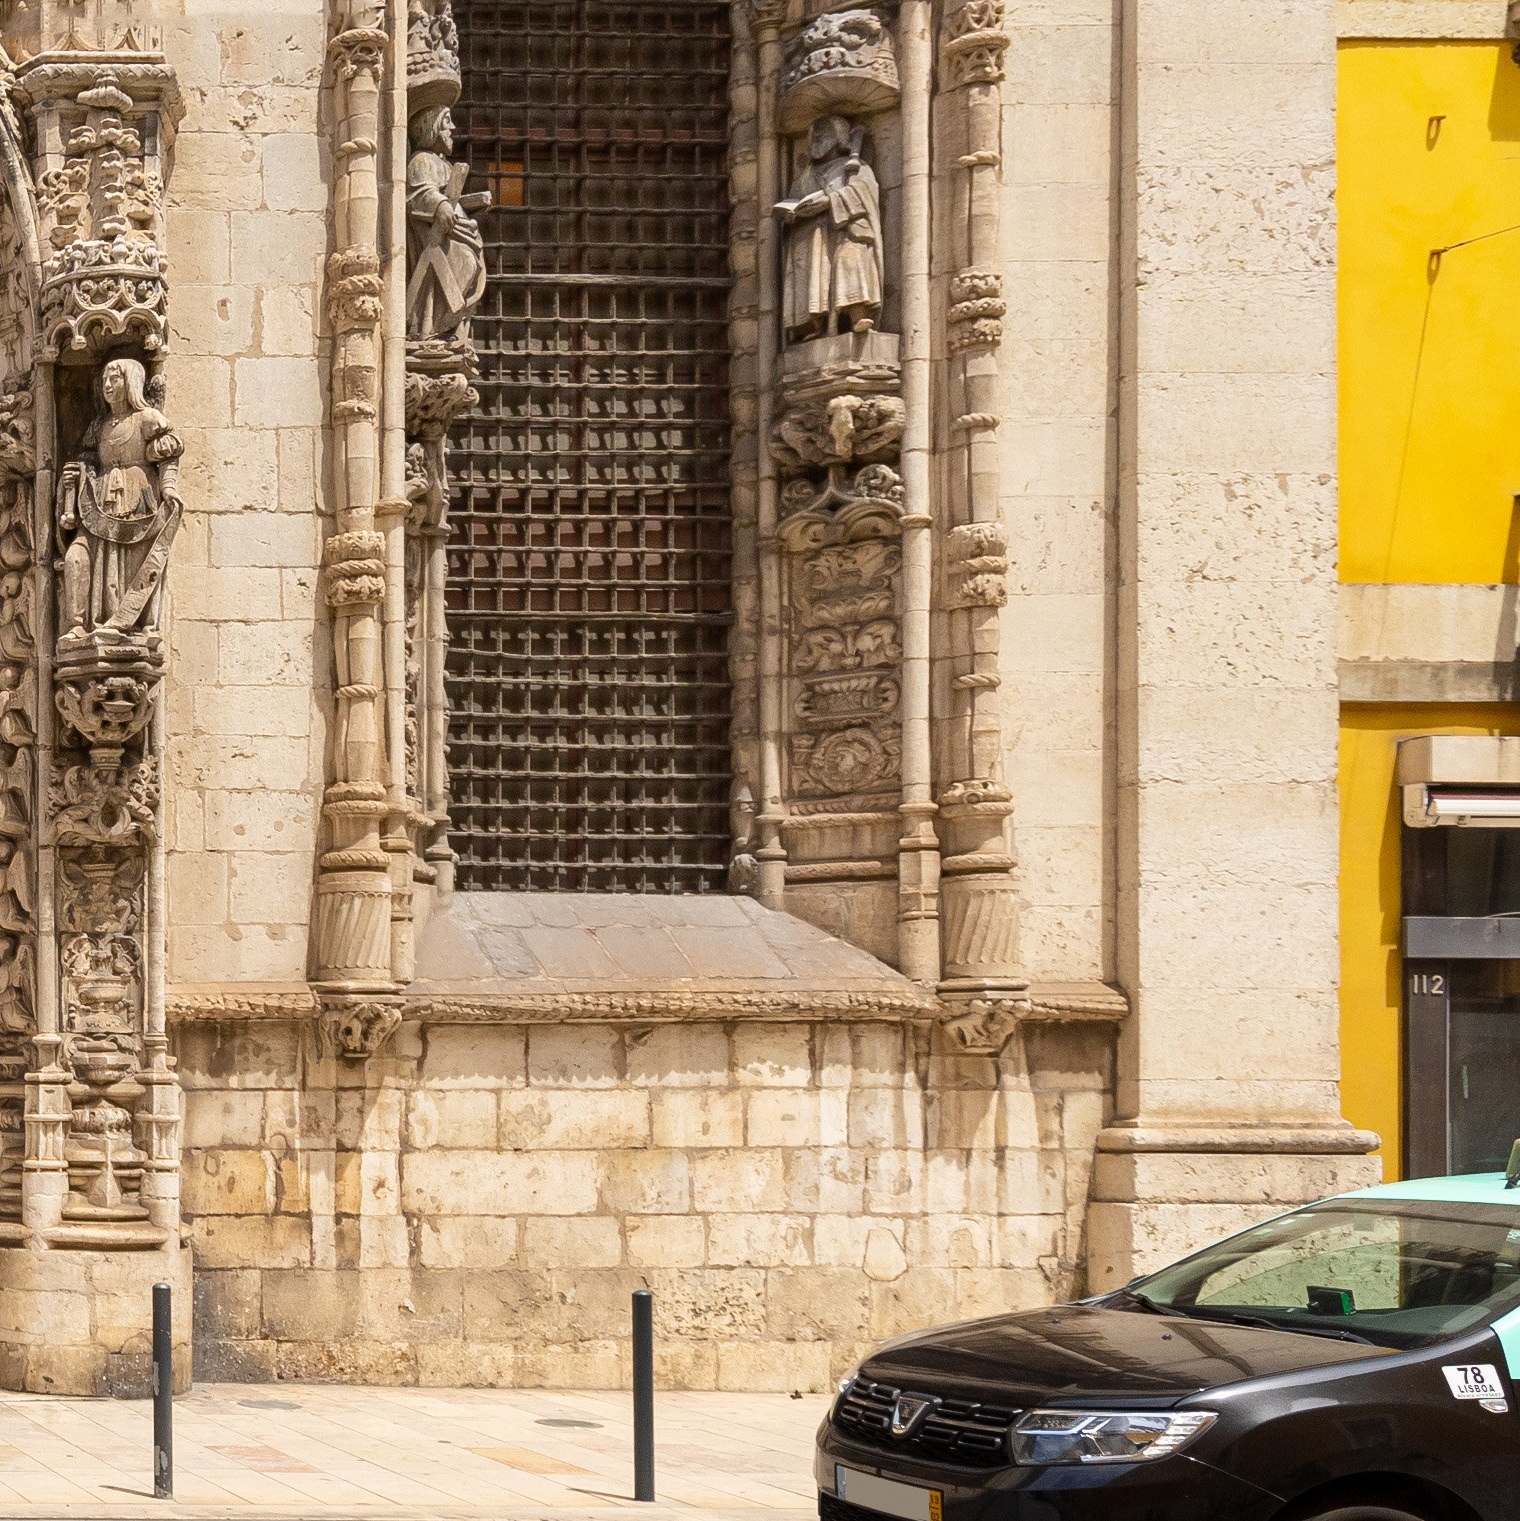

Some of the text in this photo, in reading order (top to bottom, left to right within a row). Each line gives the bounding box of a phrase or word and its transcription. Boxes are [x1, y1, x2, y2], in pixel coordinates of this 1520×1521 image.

[1413, 974, 1444, 994] 112
[1457, 1366, 1485, 1384] 78
[1458, 1384, 1495, 1393] LISBOA
